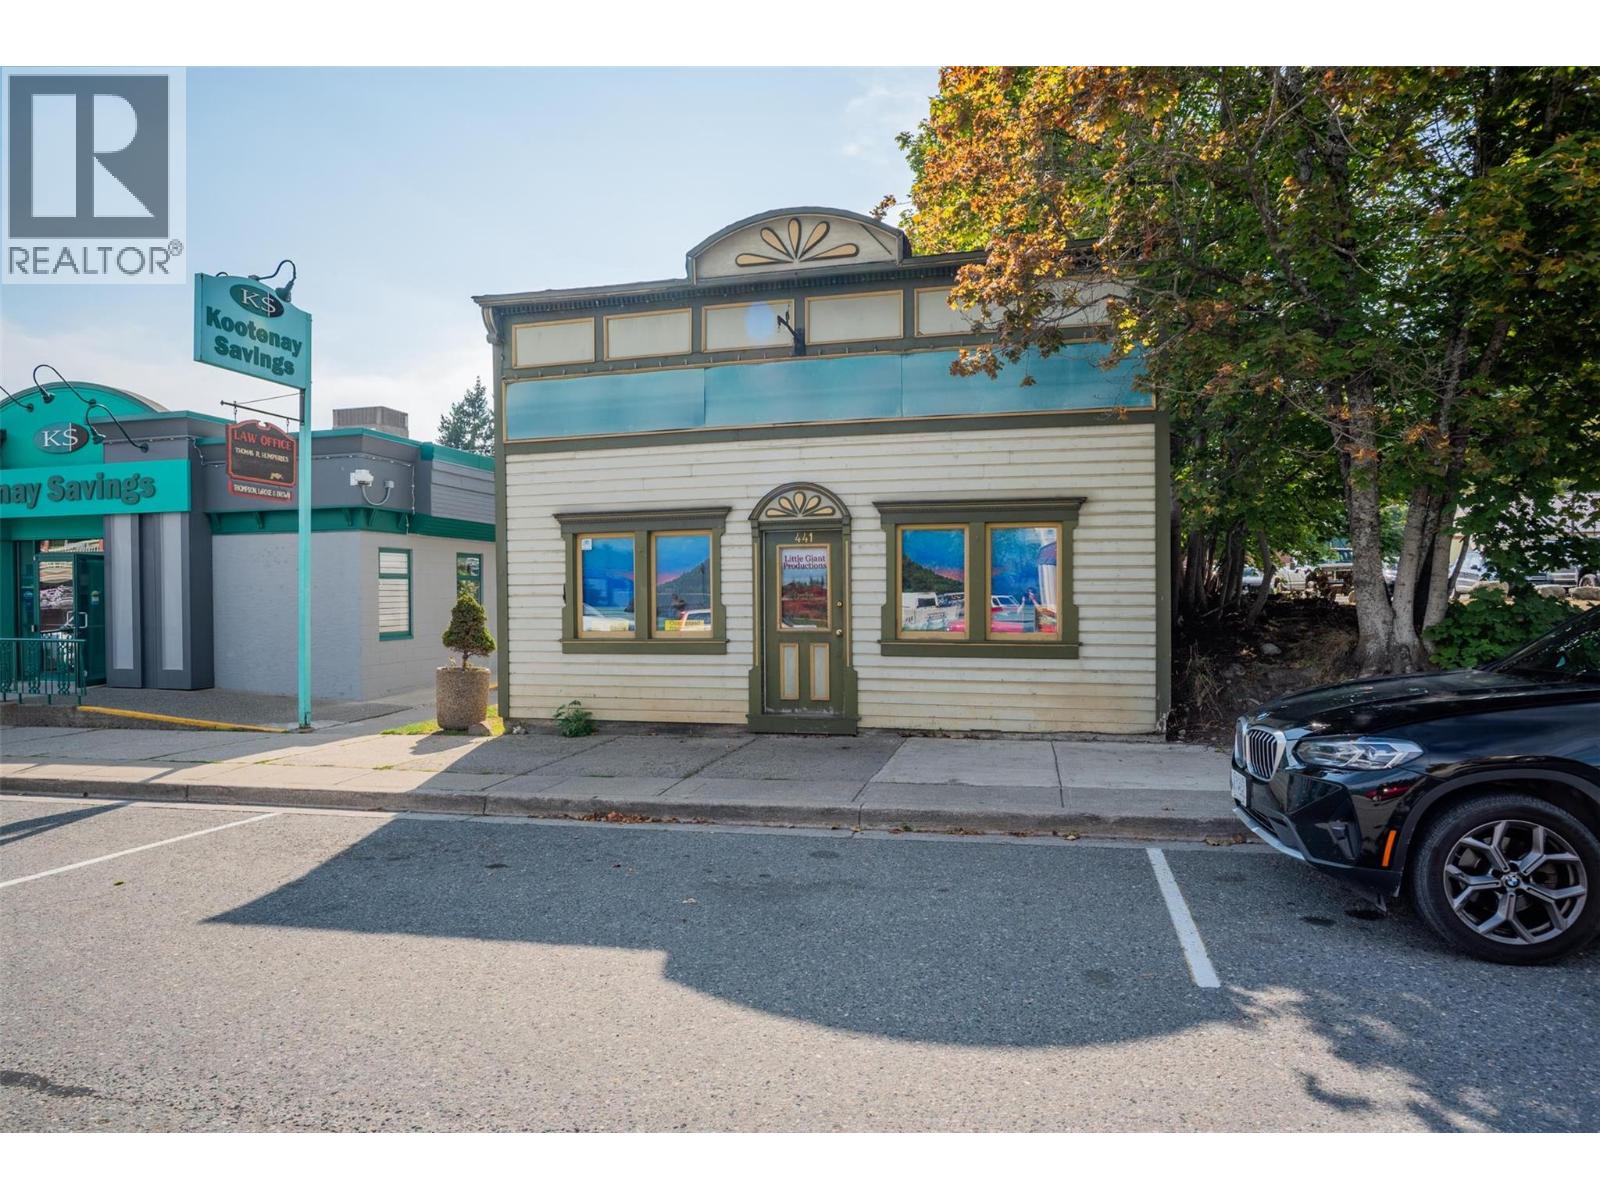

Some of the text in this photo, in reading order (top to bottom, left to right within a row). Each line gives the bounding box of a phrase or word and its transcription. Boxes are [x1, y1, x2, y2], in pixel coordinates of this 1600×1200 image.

[206, 306, 303, 358] Kootenay
[214, 335, 295, 377] Savings
[233, 430, 292, 450] LAW OFFICE
[47, 472, 156, 506] Savings
[794, 531, 813, 543] 441
[783, 562, 827, 570] Productions
[784, 555, 826, 563] Little Giant
